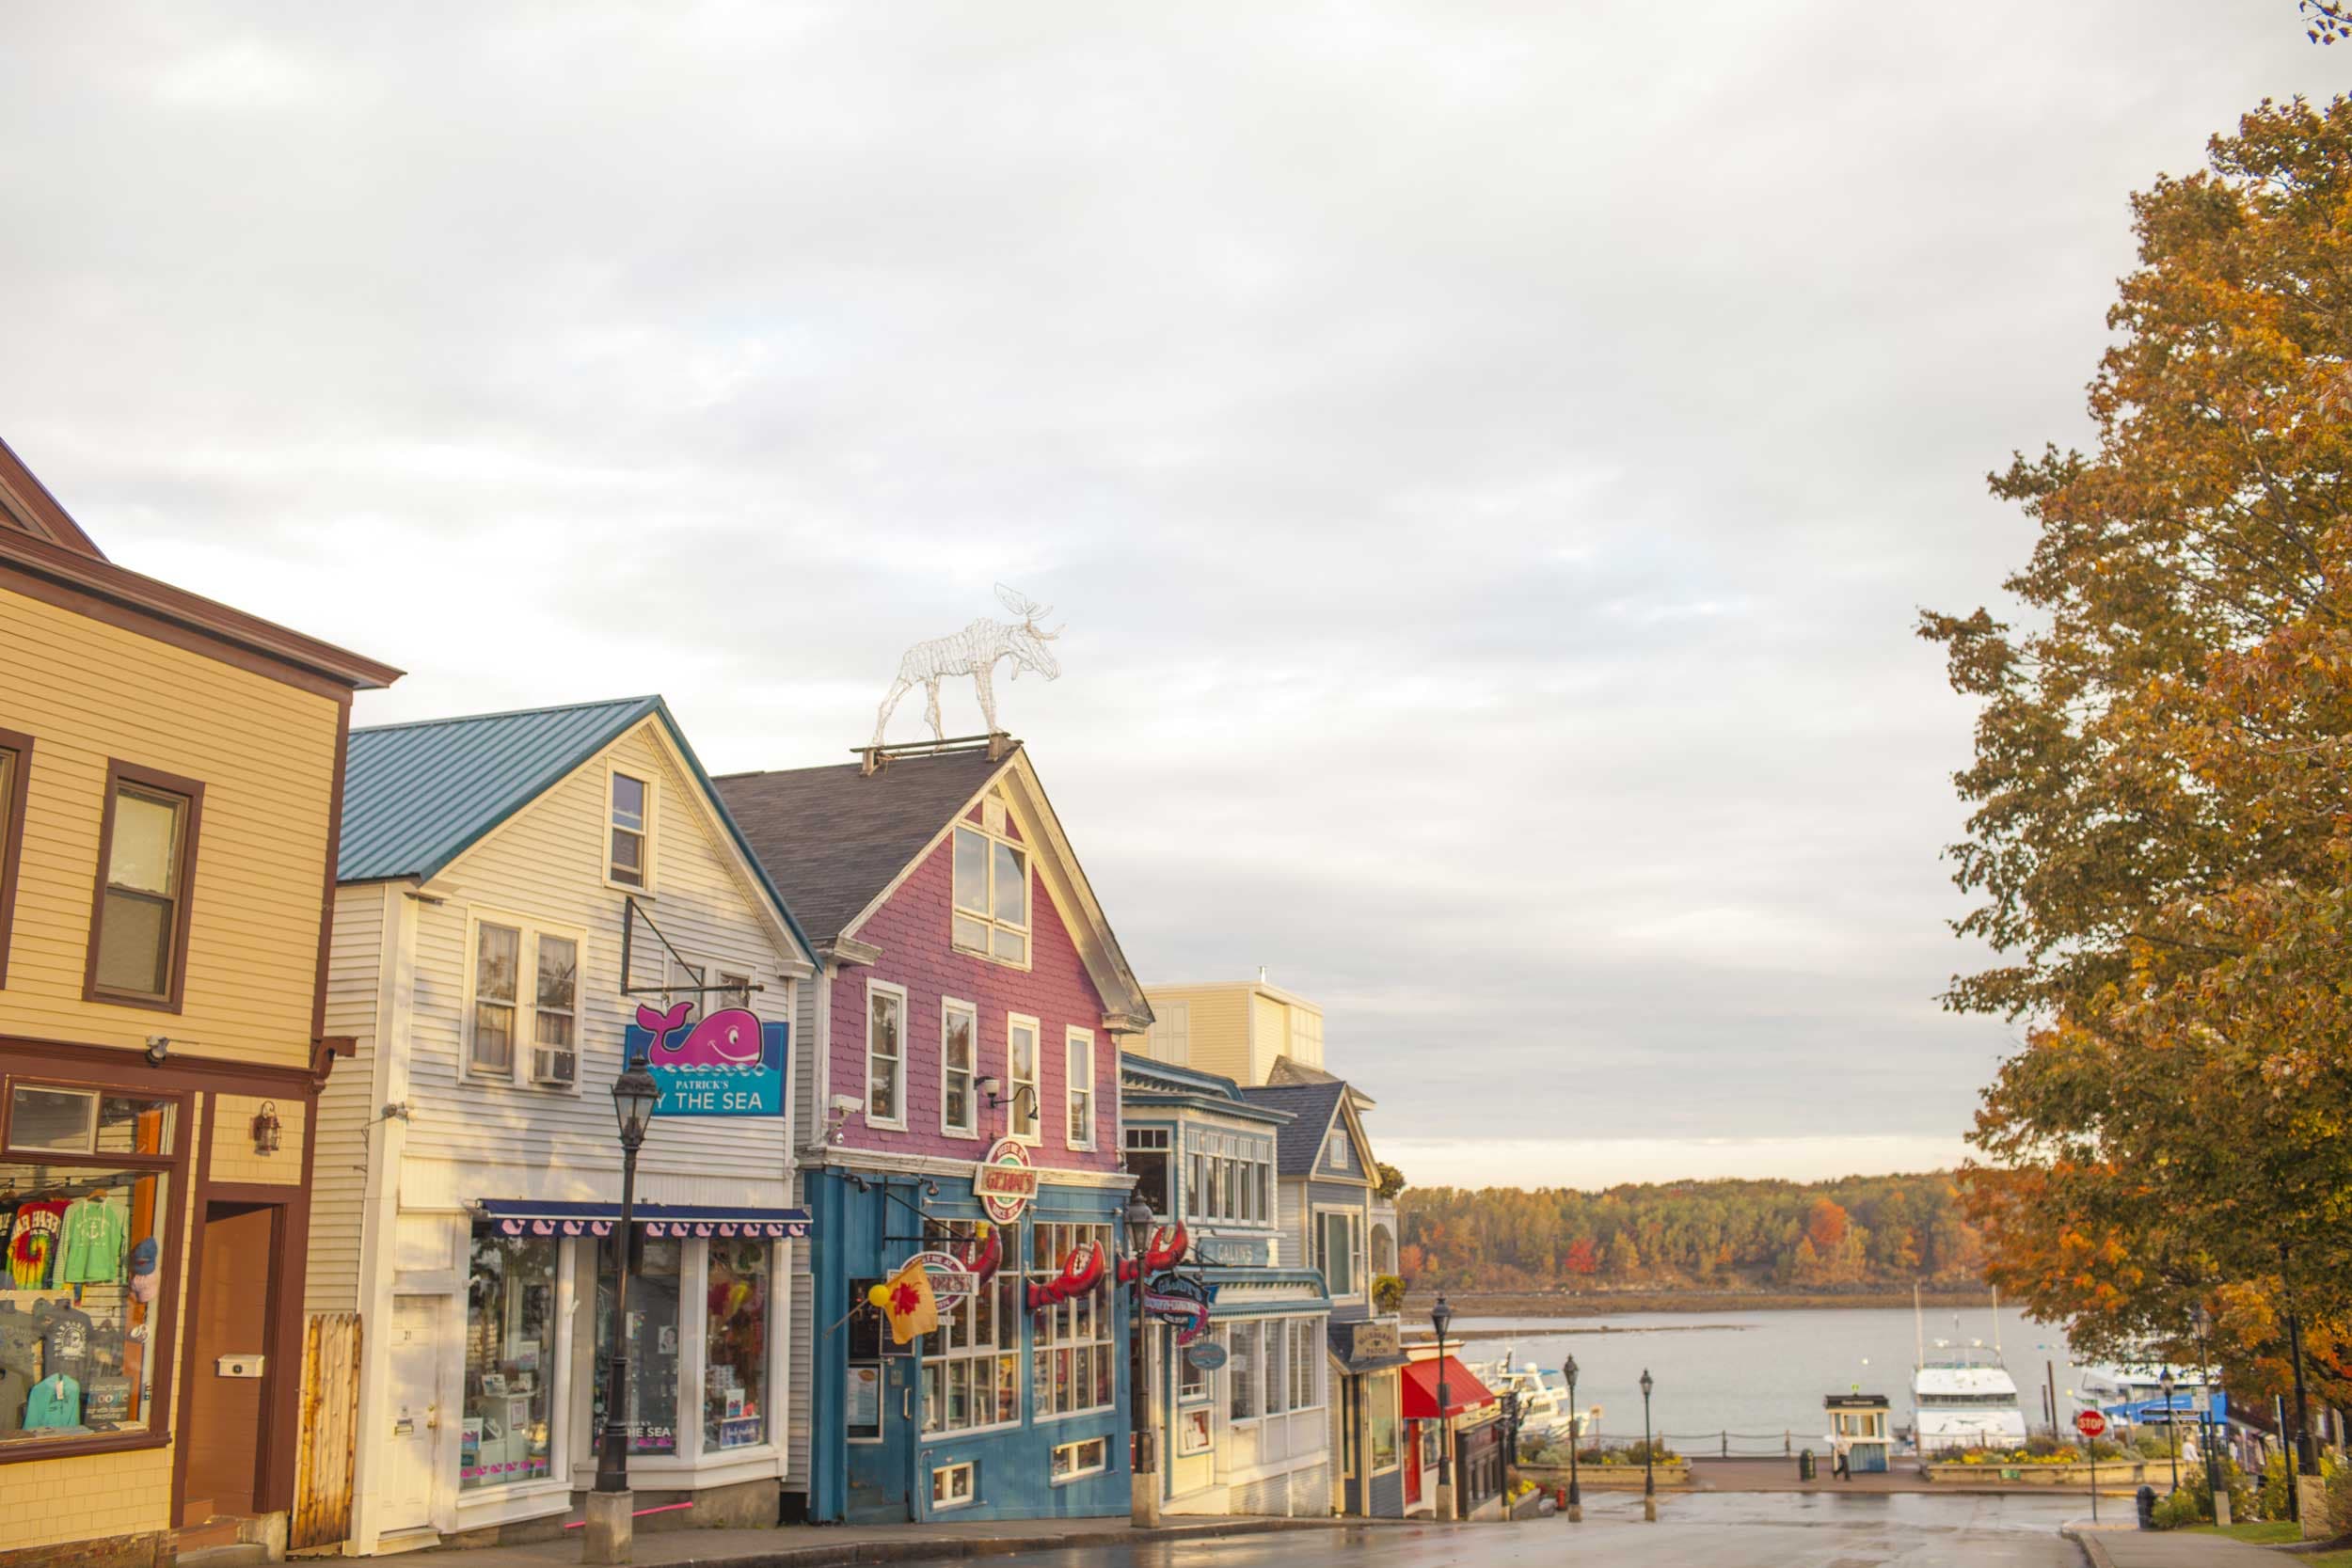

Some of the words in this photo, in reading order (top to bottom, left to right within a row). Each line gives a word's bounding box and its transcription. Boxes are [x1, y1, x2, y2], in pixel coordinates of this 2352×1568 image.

[675, 1080, 729, 1090] PATRICK'S
[675, 1092, 715, 1110] THE
[722, 1092, 763, 1110] SEA
[2078, 1417, 2105, 1430] STOP
[627, 1427, 644, 1438] HE
[646, 1426, 671, 1438] SEA
